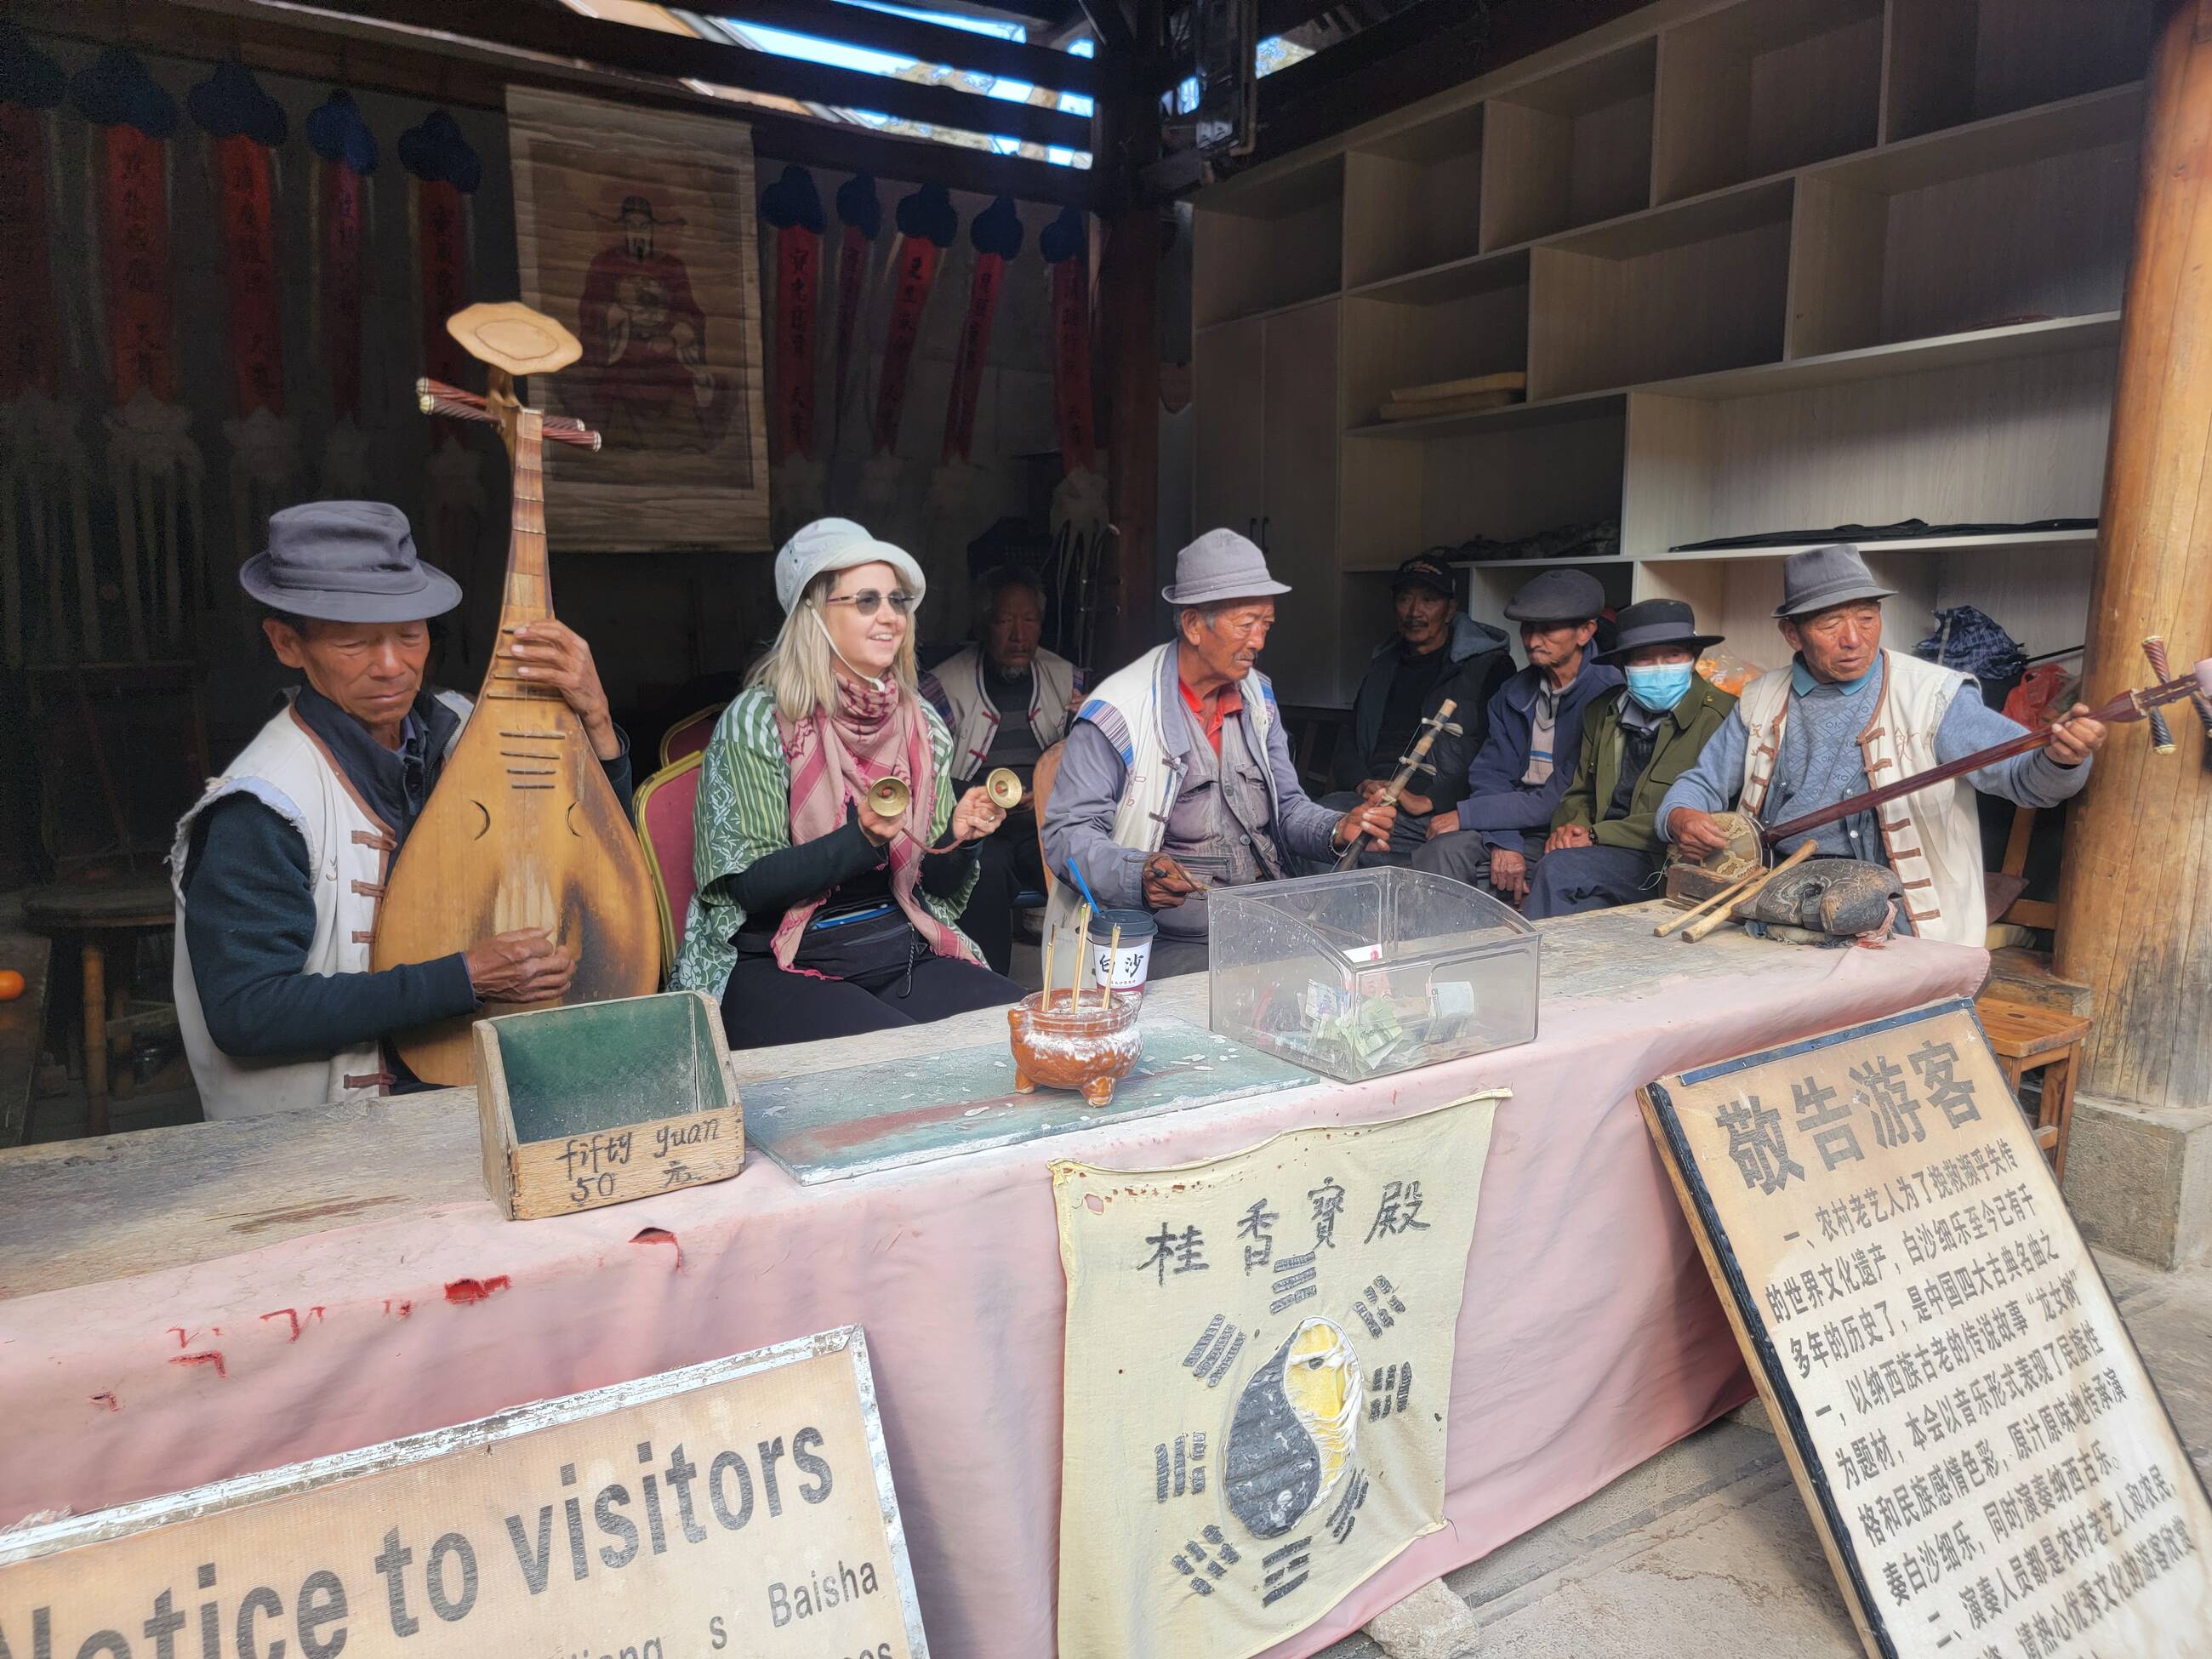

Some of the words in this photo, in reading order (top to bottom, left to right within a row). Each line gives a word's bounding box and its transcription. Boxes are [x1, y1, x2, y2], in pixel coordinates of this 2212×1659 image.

[556, 1132, 633, 1181] fifty
[1715, 1040, 1982, 1196] 敬告游客
[571, 1172, 614, 1203] 50
[1137, 1177, 1431, 1287] 桂香寶殿
[374, 1525, 479, 1639] to
[504, 1427, 835, 1596] visitors
[767, 1560, 879, 1628] Baisha
